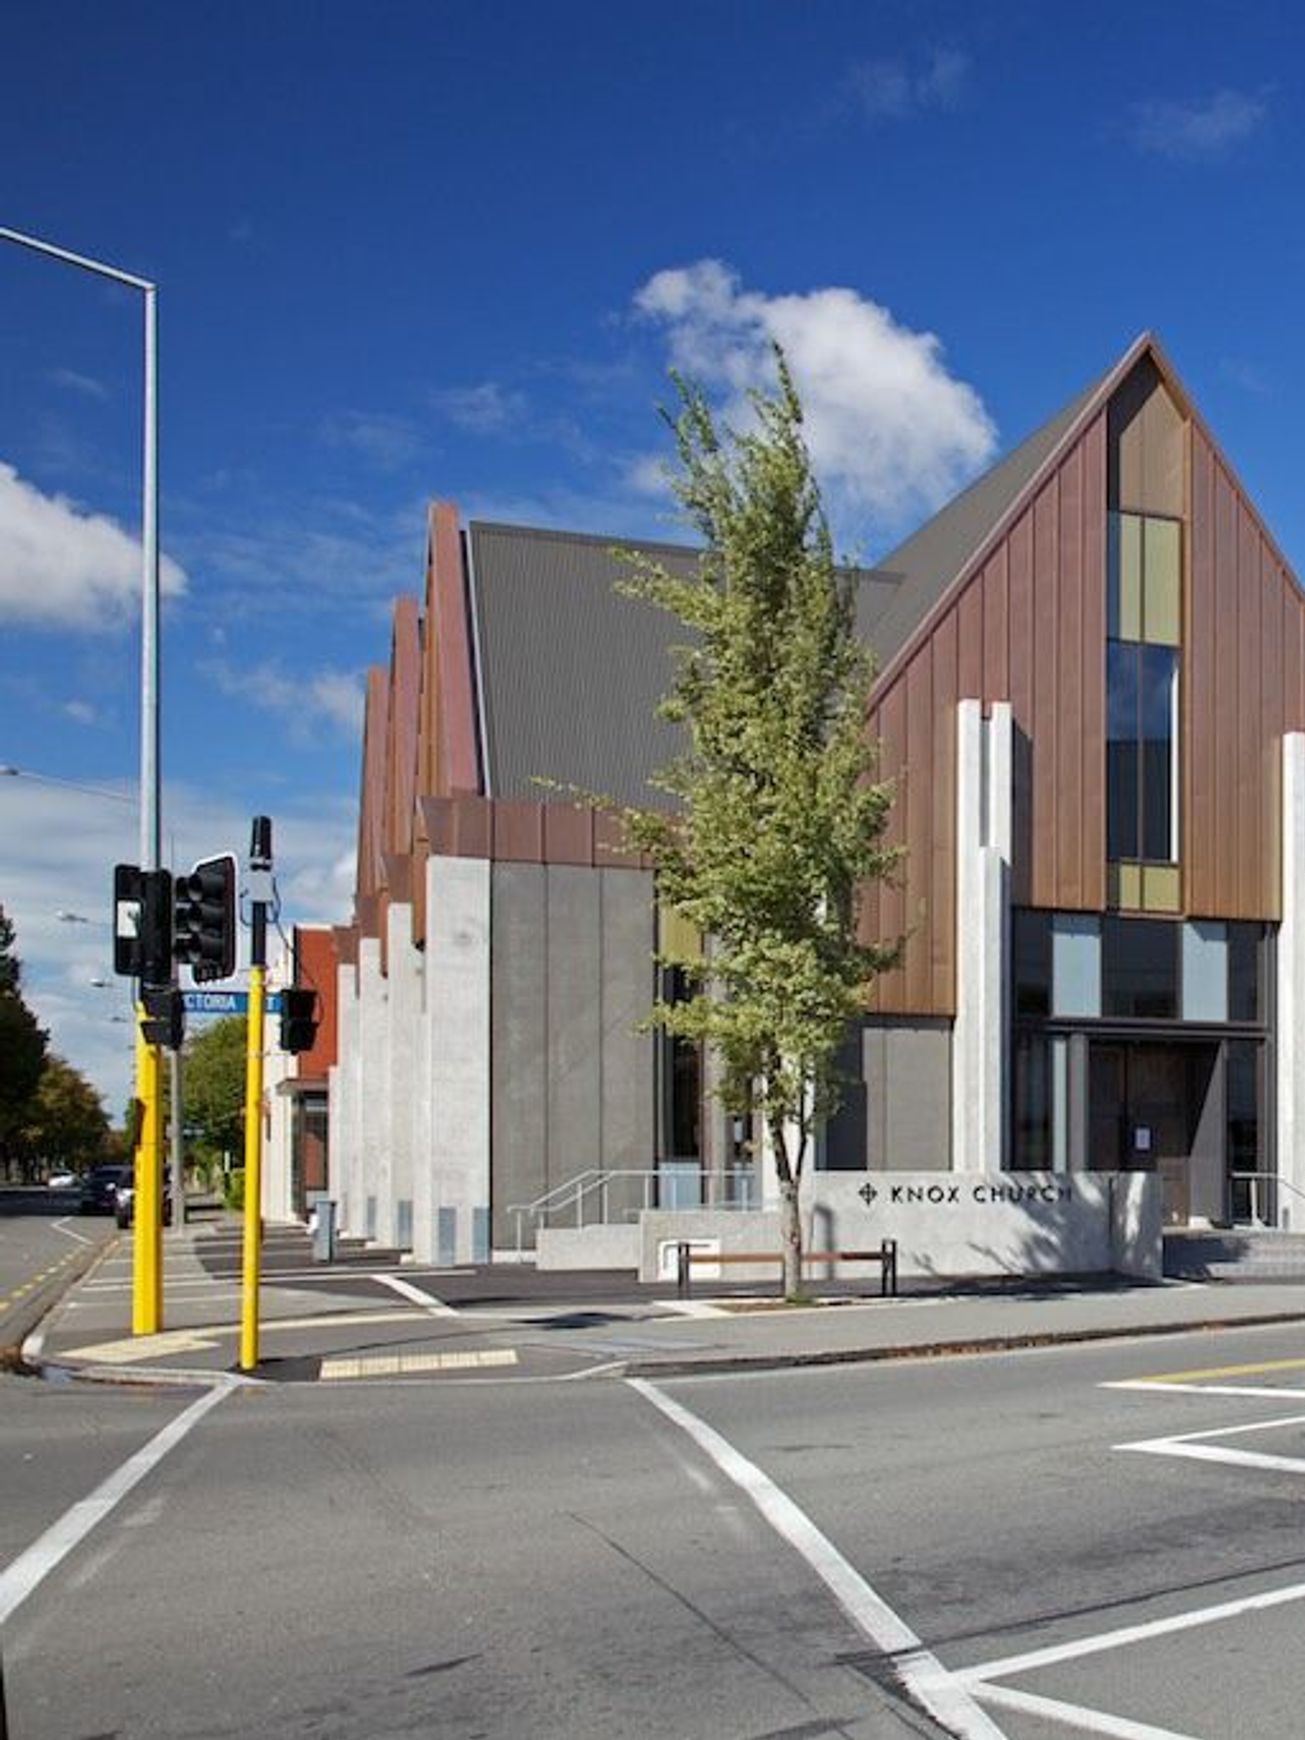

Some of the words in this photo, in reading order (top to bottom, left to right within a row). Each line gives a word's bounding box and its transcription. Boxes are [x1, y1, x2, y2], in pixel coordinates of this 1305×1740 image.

[183, 993, 236, 1009] CTORIA
[891, 1185, 960, 1204] KNOX
[973, 1185, 1072, 1204] CHURCH
